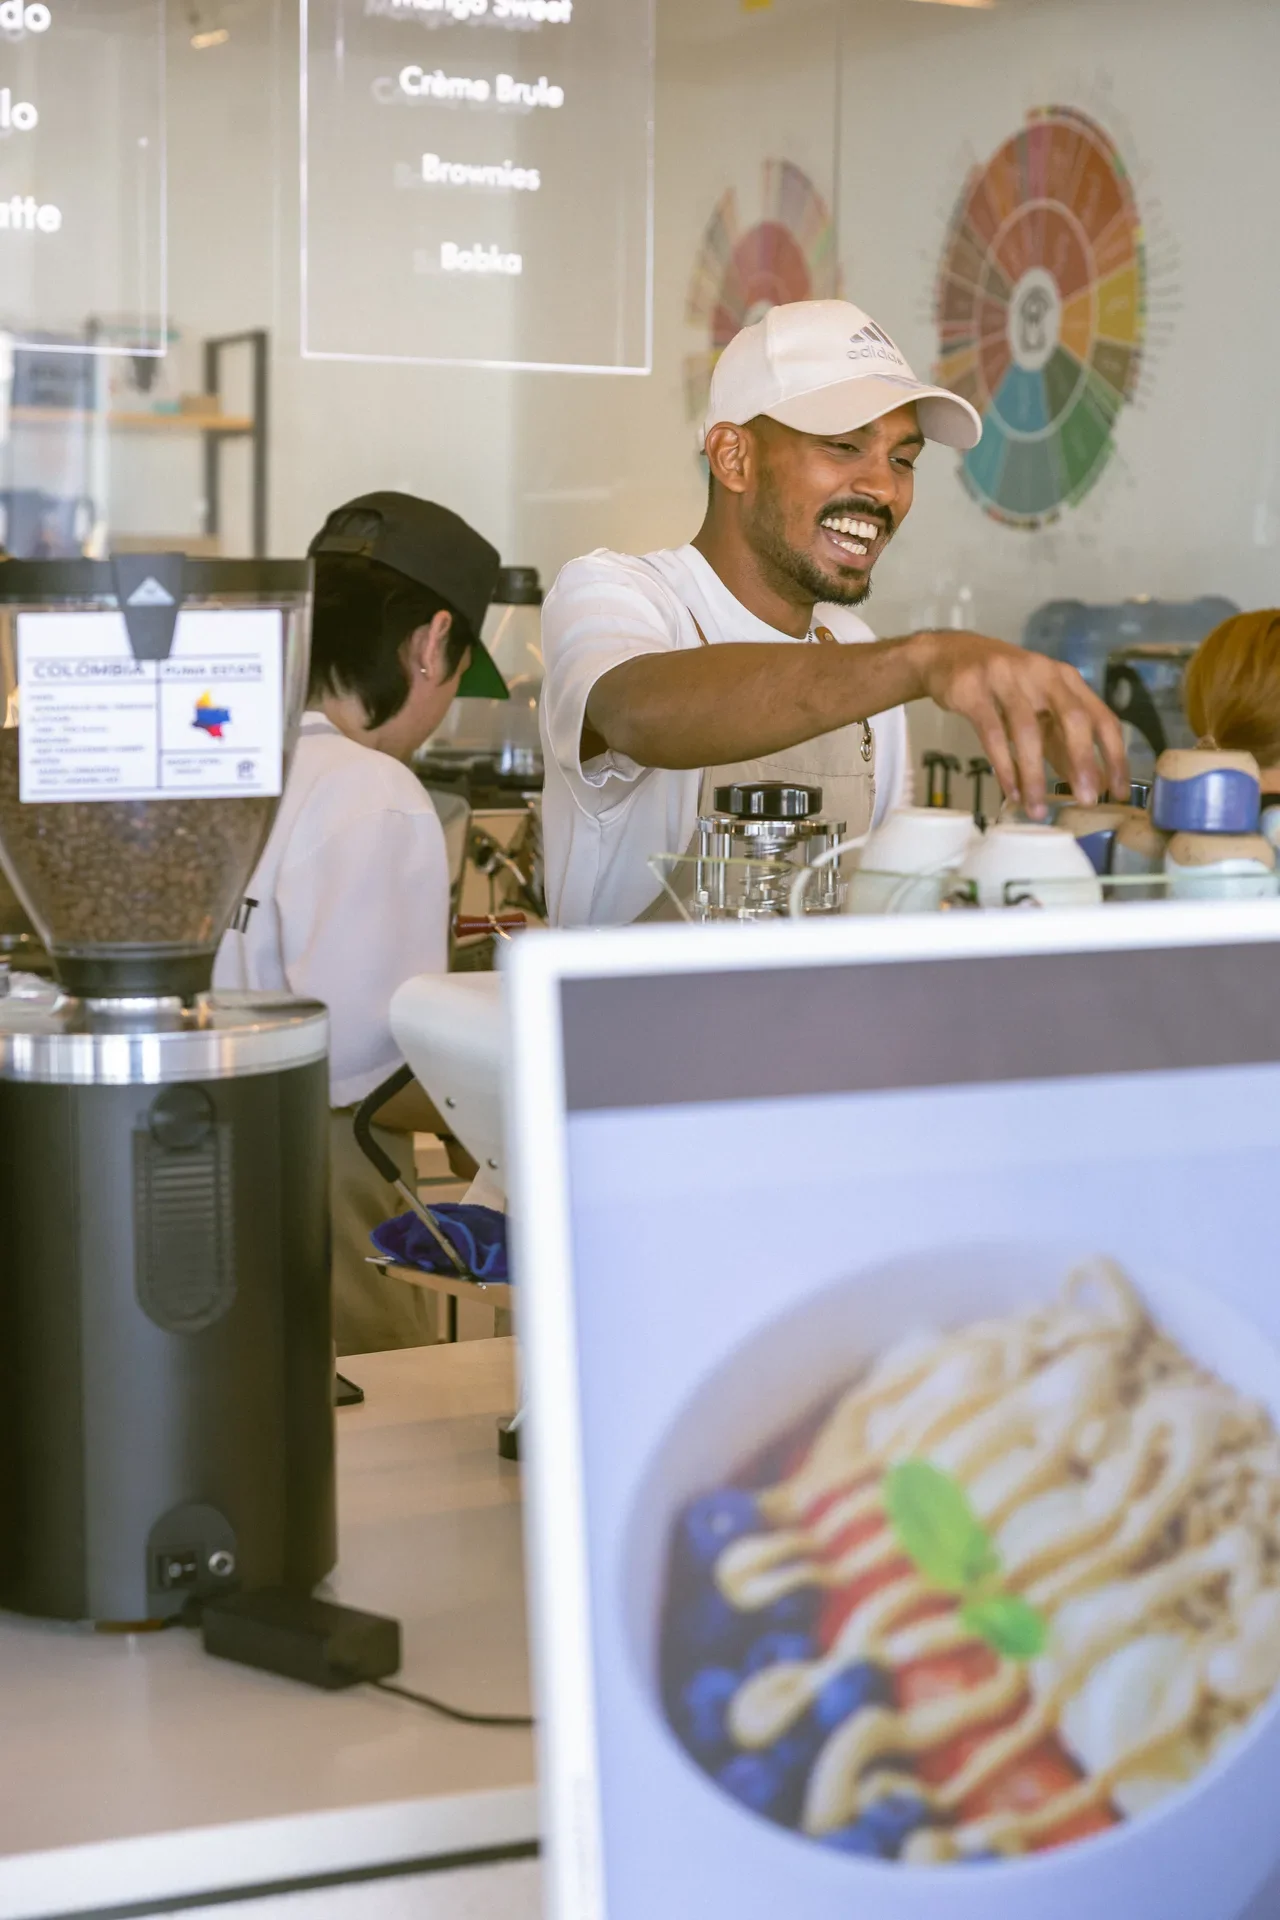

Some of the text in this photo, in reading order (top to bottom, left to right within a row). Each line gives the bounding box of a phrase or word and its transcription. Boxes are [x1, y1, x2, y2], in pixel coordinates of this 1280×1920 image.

[391, 0, 488, 20] ango
[399, 65, 565, 108] Crème Brule
[422, 152, 541, 191] Brownies
[846, 345, 904, 366] adidas
[33, 661, 145, 679] COLOMBIA
